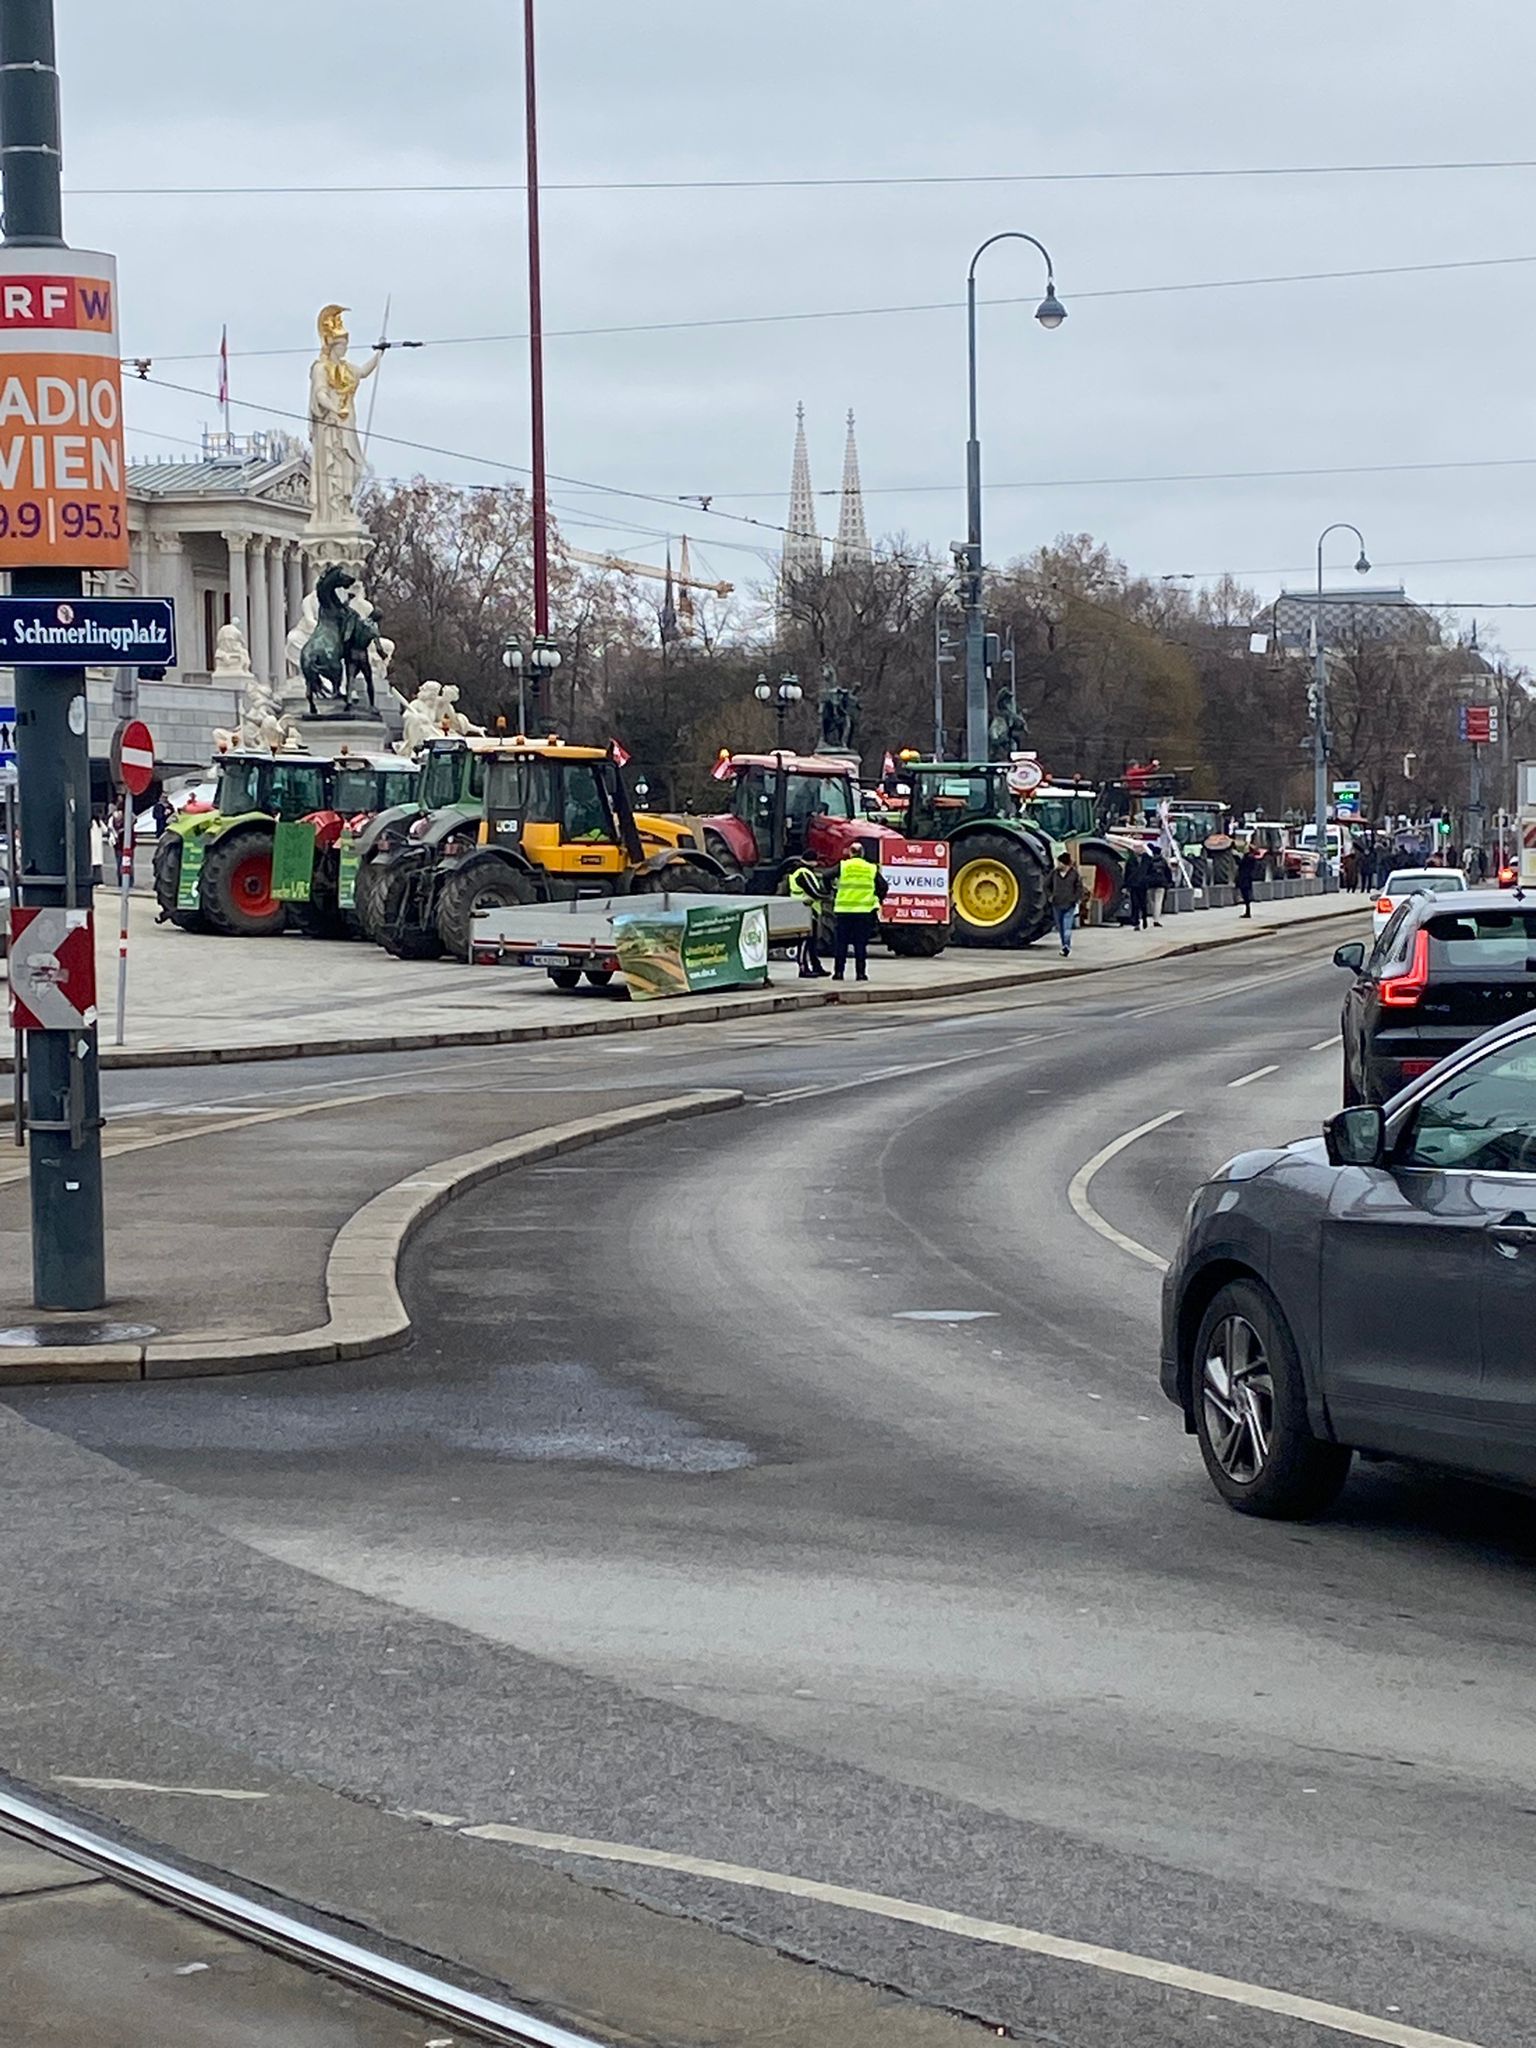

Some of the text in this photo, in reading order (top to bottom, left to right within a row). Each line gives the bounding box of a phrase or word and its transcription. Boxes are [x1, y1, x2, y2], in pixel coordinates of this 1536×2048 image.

[3, 285, 110, 320] RF W
[0, 376, 118, 429] ADIO
[61, 501, 121, 540] 95.3
[13, 618, 167, 652] Schmerlingplatz
[496, 820, 518, 832] JCB
[885, 874, 945, 888] ZU WENIG
